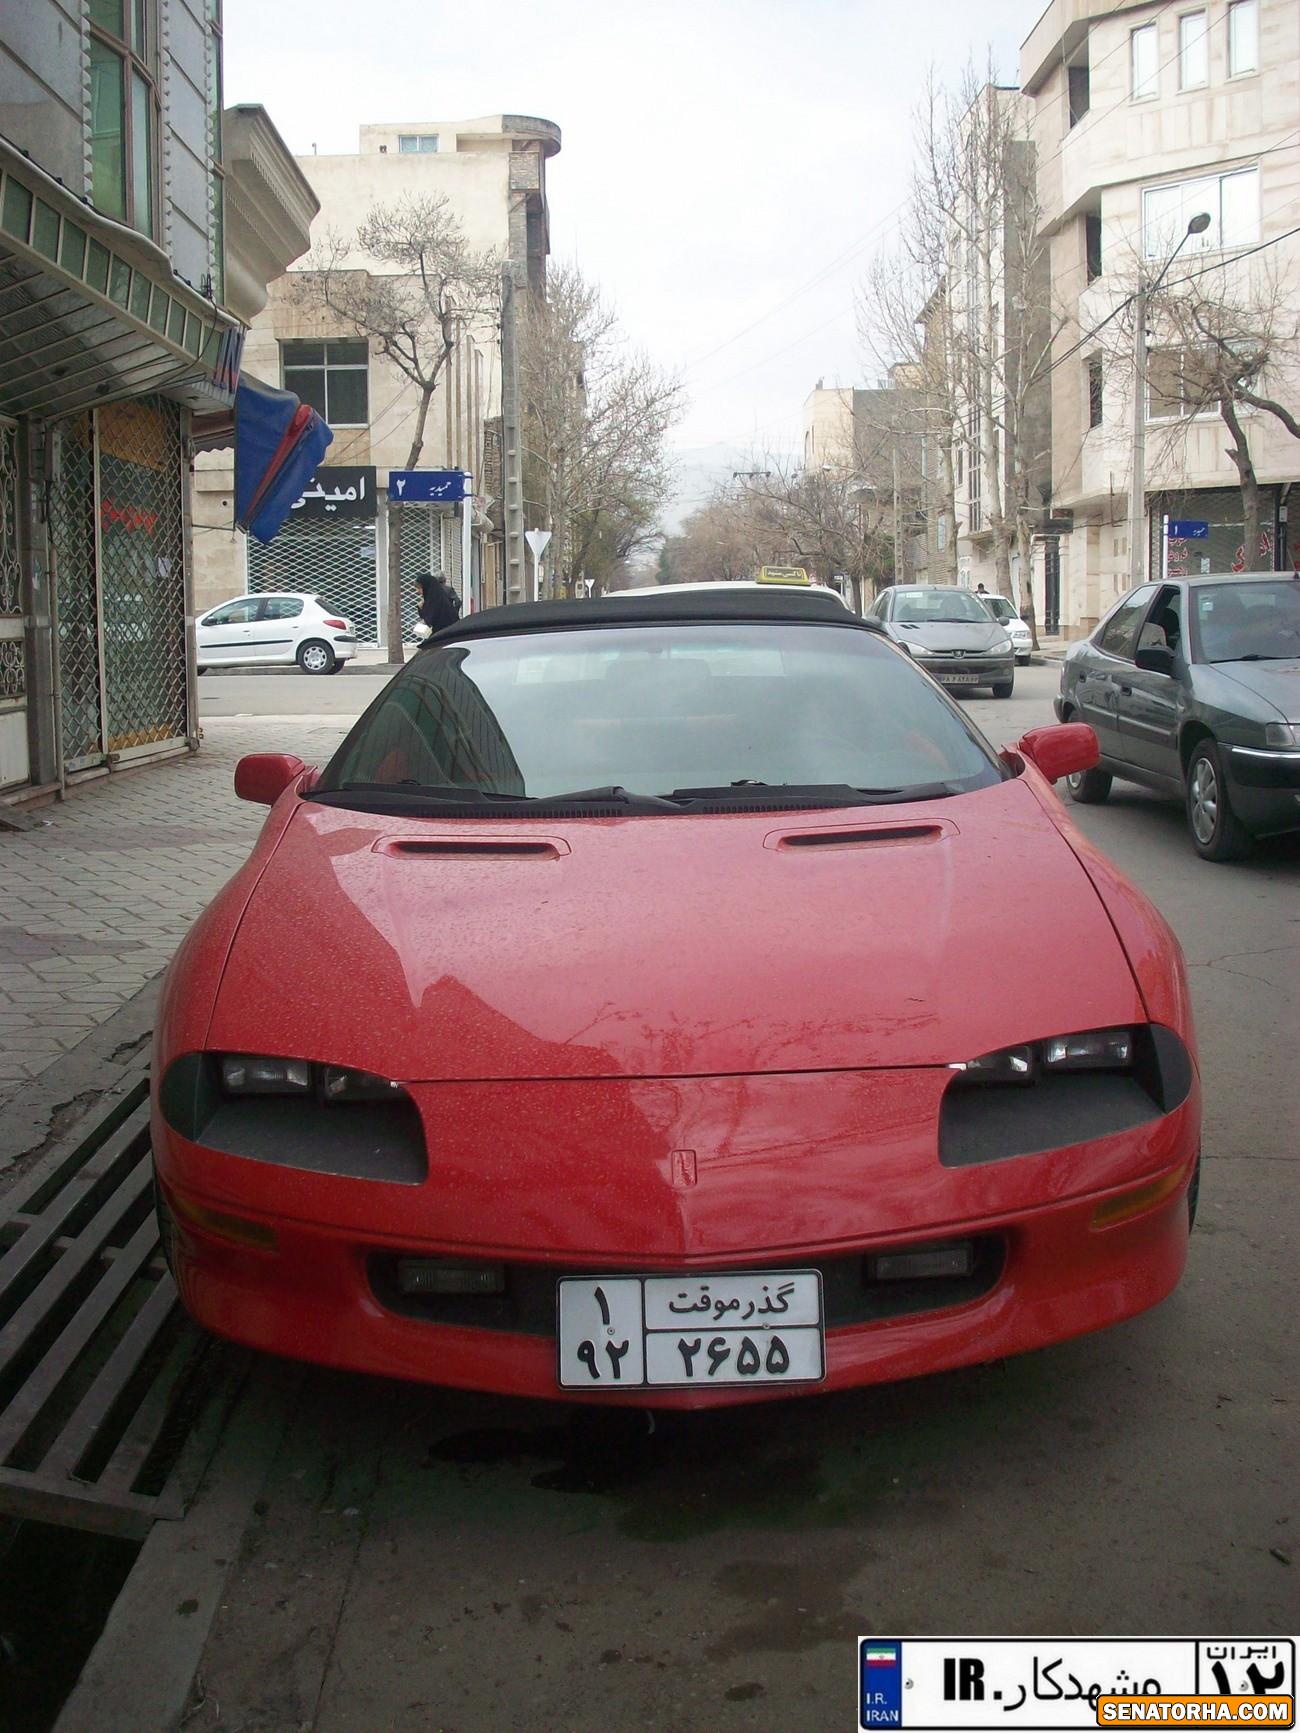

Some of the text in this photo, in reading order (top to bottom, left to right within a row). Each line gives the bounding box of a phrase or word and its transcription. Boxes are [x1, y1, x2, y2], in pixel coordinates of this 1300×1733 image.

[396, 479, 406, 497] ۲
[594, 1286, 610, 1325] ۱
[668, 1282, 795, 1321] گذر موقت
[577, 1339, 630, 1379] ۹۲
[677, 1335, 790, 1377] ۲۶۵۵
